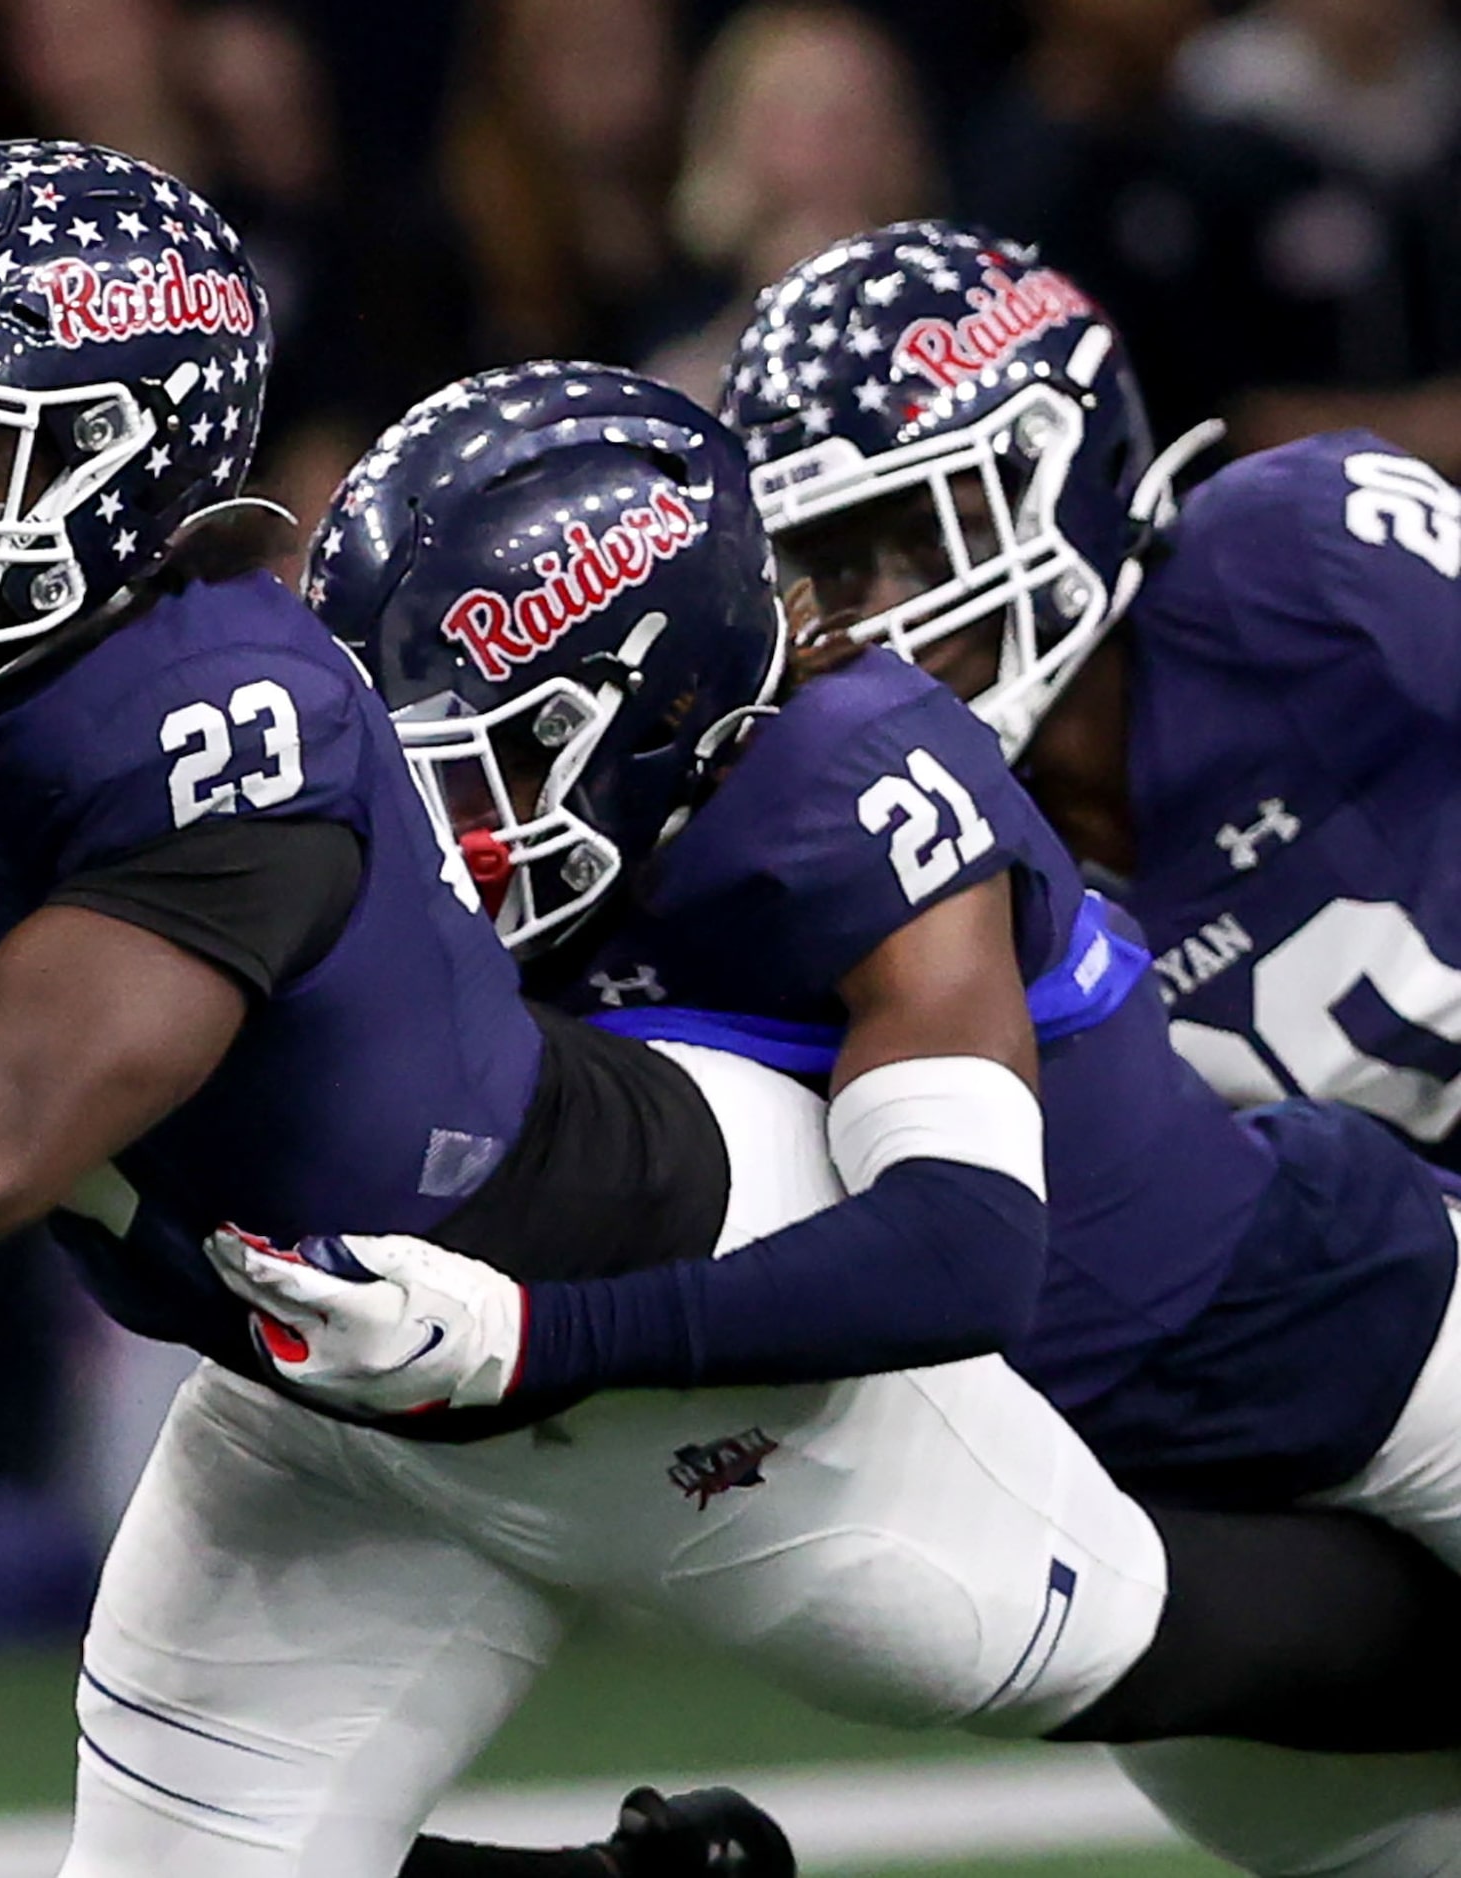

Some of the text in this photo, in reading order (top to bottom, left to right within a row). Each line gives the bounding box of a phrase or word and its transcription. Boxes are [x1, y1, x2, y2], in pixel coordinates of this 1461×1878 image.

[31, 247, 253, 350] Raiders
[440, 490, 695, 681] Raiders
[160, 680, 304, 828] 23
[858, 747, 996, 904] 21
